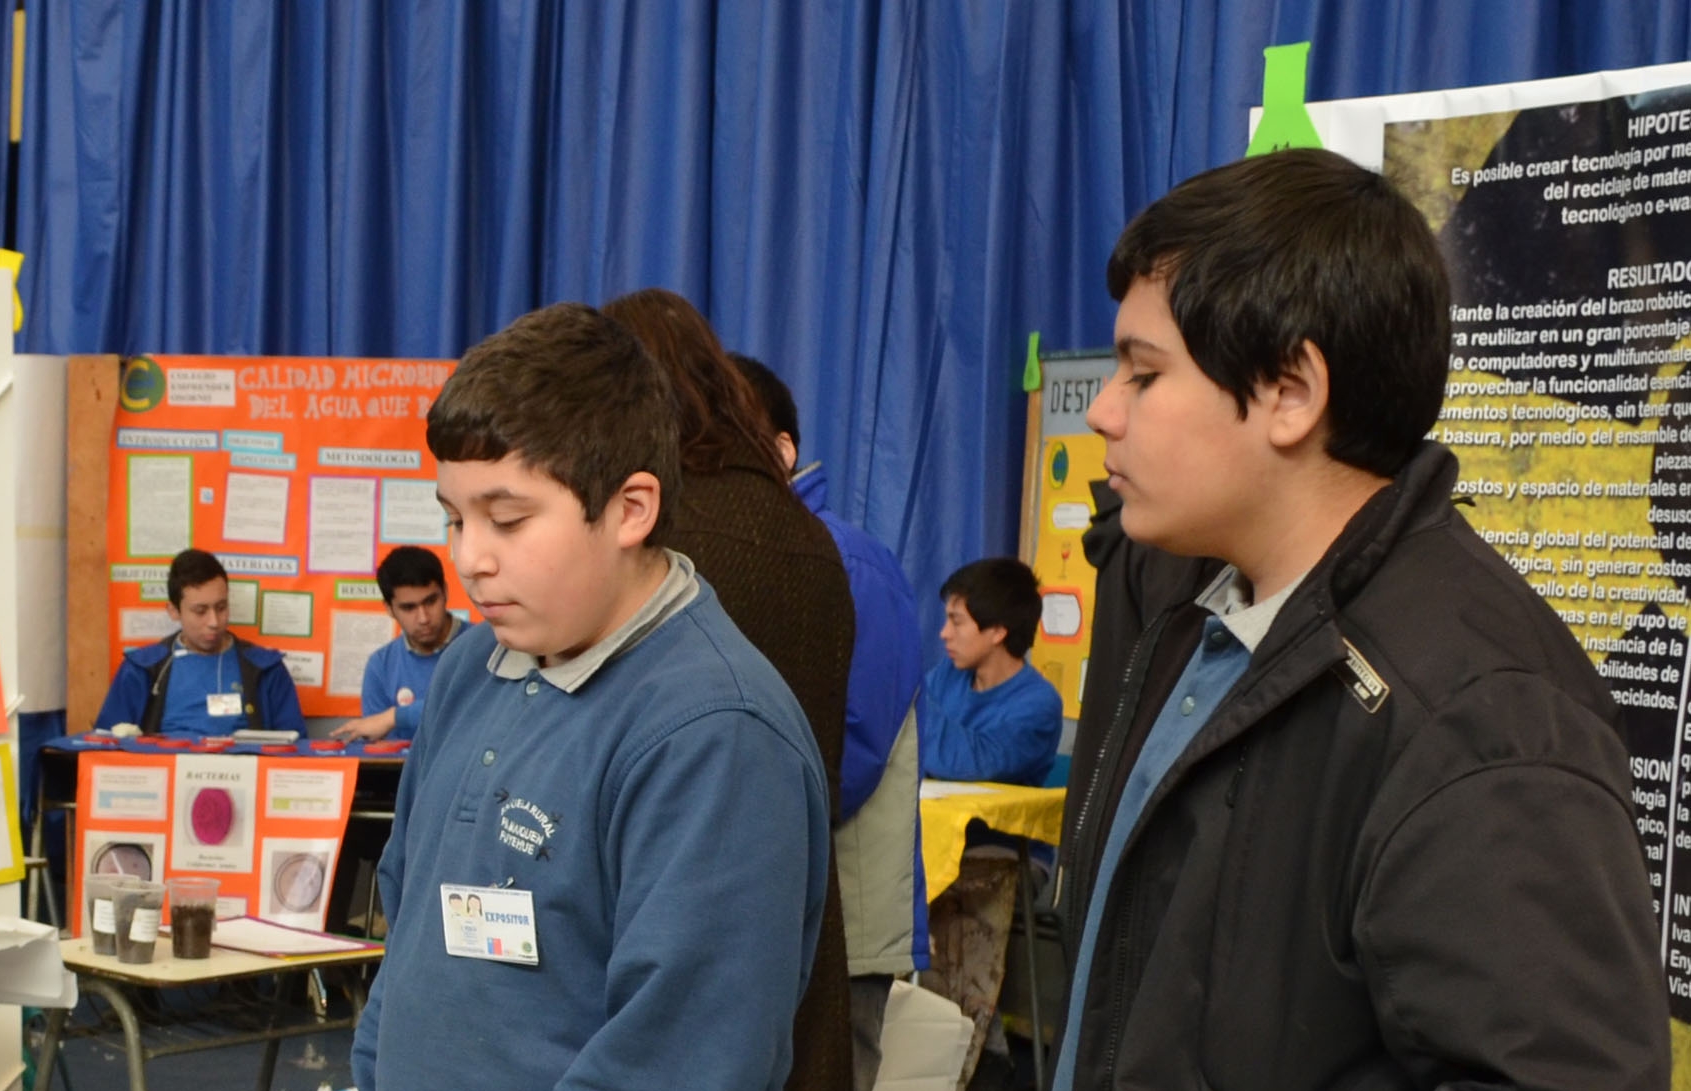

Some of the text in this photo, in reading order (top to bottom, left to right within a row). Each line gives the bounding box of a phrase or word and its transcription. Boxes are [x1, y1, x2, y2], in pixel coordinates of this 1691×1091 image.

[1628, 110, 1691, 138] HIPOTE
[1451, 168, 1470, 185] Es
[1473, 161, 1523, 187] posible
[1526, 158, 1569, 177] crear
[1644, 146, 1670, 167] por
[1544, 181, 1569, 201] del
[1573, 176, 1631, 199] reciclaje
[1633, 172, 1649, 190] de
[1561, 195, 1691, 225] tecnológico o e-wa
[1495, 302, 1509, 320] la
[1512, 300, 1577, 320] creación
[1580, 297, 1606, 316] del
[1608, 297, 1644, 315] brazo
[1471, 327, 1537, 346] reutilizar
[1539, 329, 1558, 344] en
[1561, 328, 1583, 343] un
[1586, 326, 1621, 346] gran
[1623, 317, 1690, 344] porcentaje
[1468, 352, 1577, 375] computadores
[1579, 352, 1591, 372] y
[237, 366, 336, 391] CALIDAD
[1444, 377, 1531, 398] provechar
[1533, 377, 1546, 394] la
[1548, 373, 1648, 393] funcionalidad
[247, 395, 294, 420] DEL
[1615, 402, 1636, 418] sin
[1638, 402, 1671, 418] tener
[1443, 427, 1506, 447] basura,
[1509, 430, 1536, 448] por
[1539, 427, 1586, 445] medio
[1590, 427, 1613, 445] del
[1616, 427, 1678, 444] ensamble
[1506, 482, 1517, 499] y
[1520, 480, 1580, 499] espacio
[1583, 479, 1602, 496] de
[1605, 479, 1677, 497] materiales
[1533, 529, 1580, 550] global
[1583, 530, 1606, 547] del
[1610, 531, 1674, 551] potencial
[1676, 533, 1691, 550] de
[1561, 555, 1583, 573] sin
[1586, 560, 1644, 578] generar
[1646, 560, 1691, 578] costos
[340, 586, 383, 598] RESUL
[1568, 582, 1589, 598] de
[1591, 583, 1605, 600] la
[1608, 585, 1690, 607] creatividad,
[1589, 611, 1608, 625] en
[1610, 610, 1624, 626] el
[1624, 613, 1665, 632] grupo
[1667, 612, 1687, 630] de
[1584, 633, 1683, 657] instancia de la
[1660, 665, 1680, 684] de
[1677, 803, 1690, 822] la
[485, 911, 530, 926] EXPOSITOR
